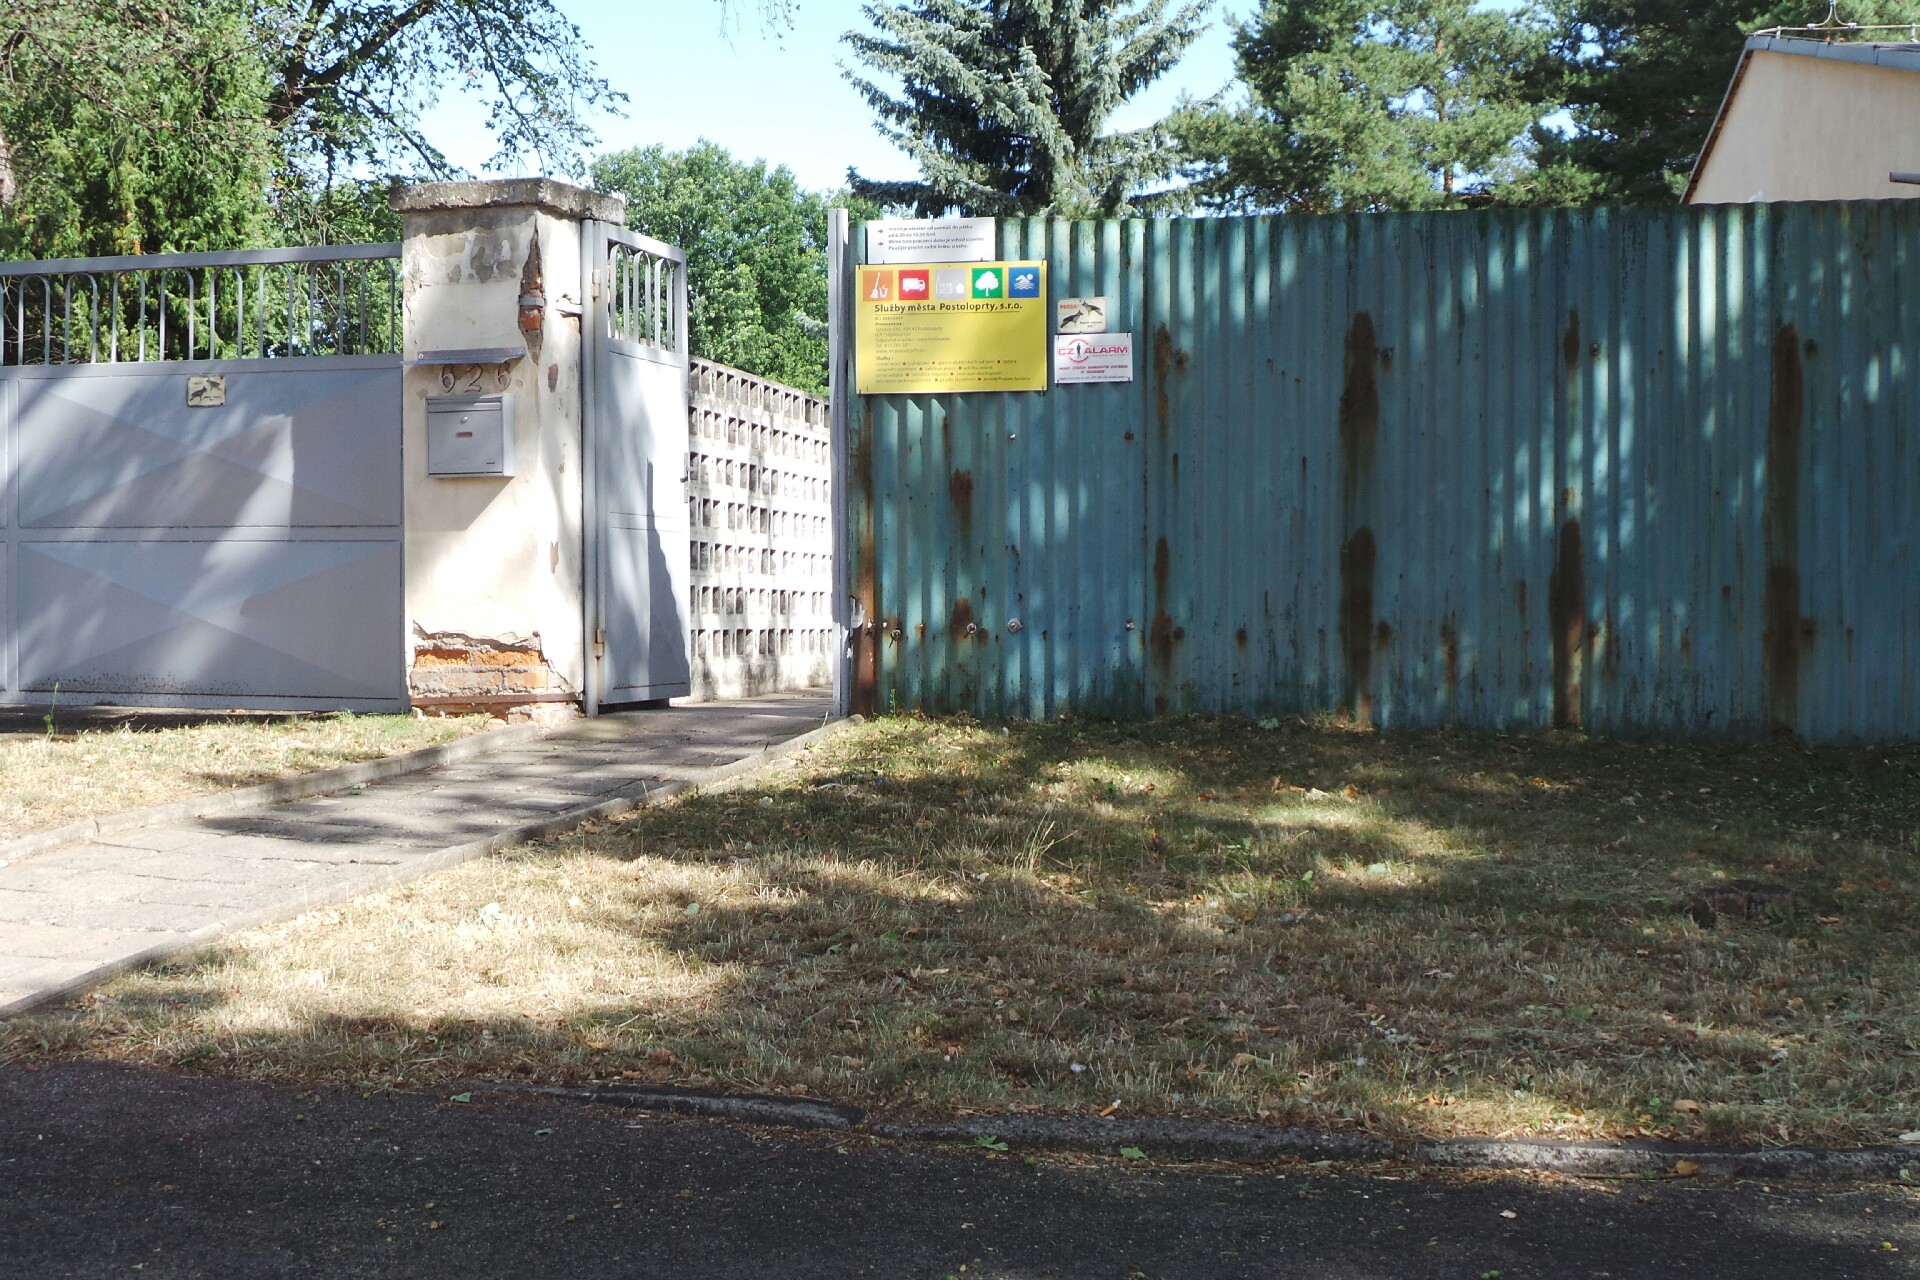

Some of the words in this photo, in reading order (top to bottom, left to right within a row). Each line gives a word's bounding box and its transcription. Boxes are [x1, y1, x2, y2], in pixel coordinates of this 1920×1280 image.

[875, 303, 906, 314] Služby
[907, 303, 936, 312] města
[939, 302, 998, 312] Postoloprty,
[1000, 302, 1023, 310] s.r.o.
[1084, 346, 1128, 354] ALARM
[440, 363, 511, 394] 626
